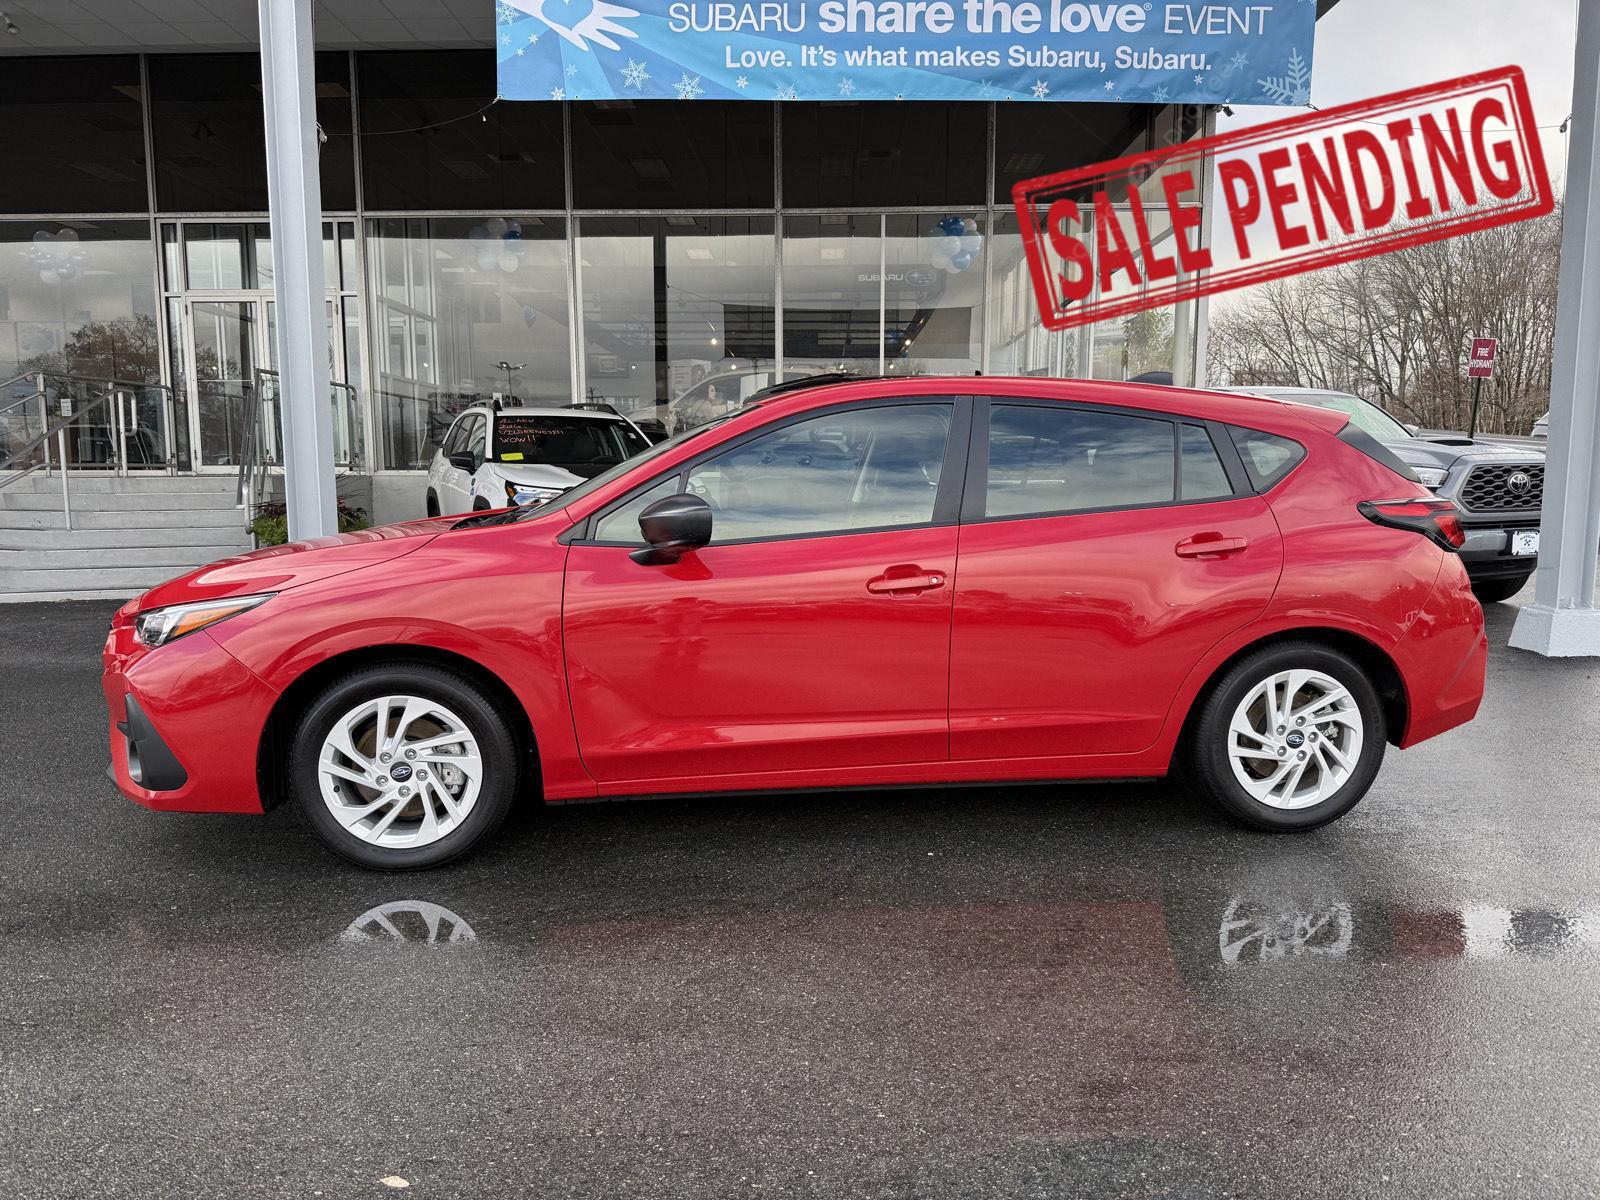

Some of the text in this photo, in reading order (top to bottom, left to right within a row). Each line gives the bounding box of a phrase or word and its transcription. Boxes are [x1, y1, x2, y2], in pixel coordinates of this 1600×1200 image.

[668, 2, 806, 33] SUBARU
[818, 0, 955, 34] share
[963, 0, 1042, 34] the
[1163, 4, 1273, 35] EVENT
[724, 45, 1213, 72] Love. It's what makes Subaru, Subaru.
